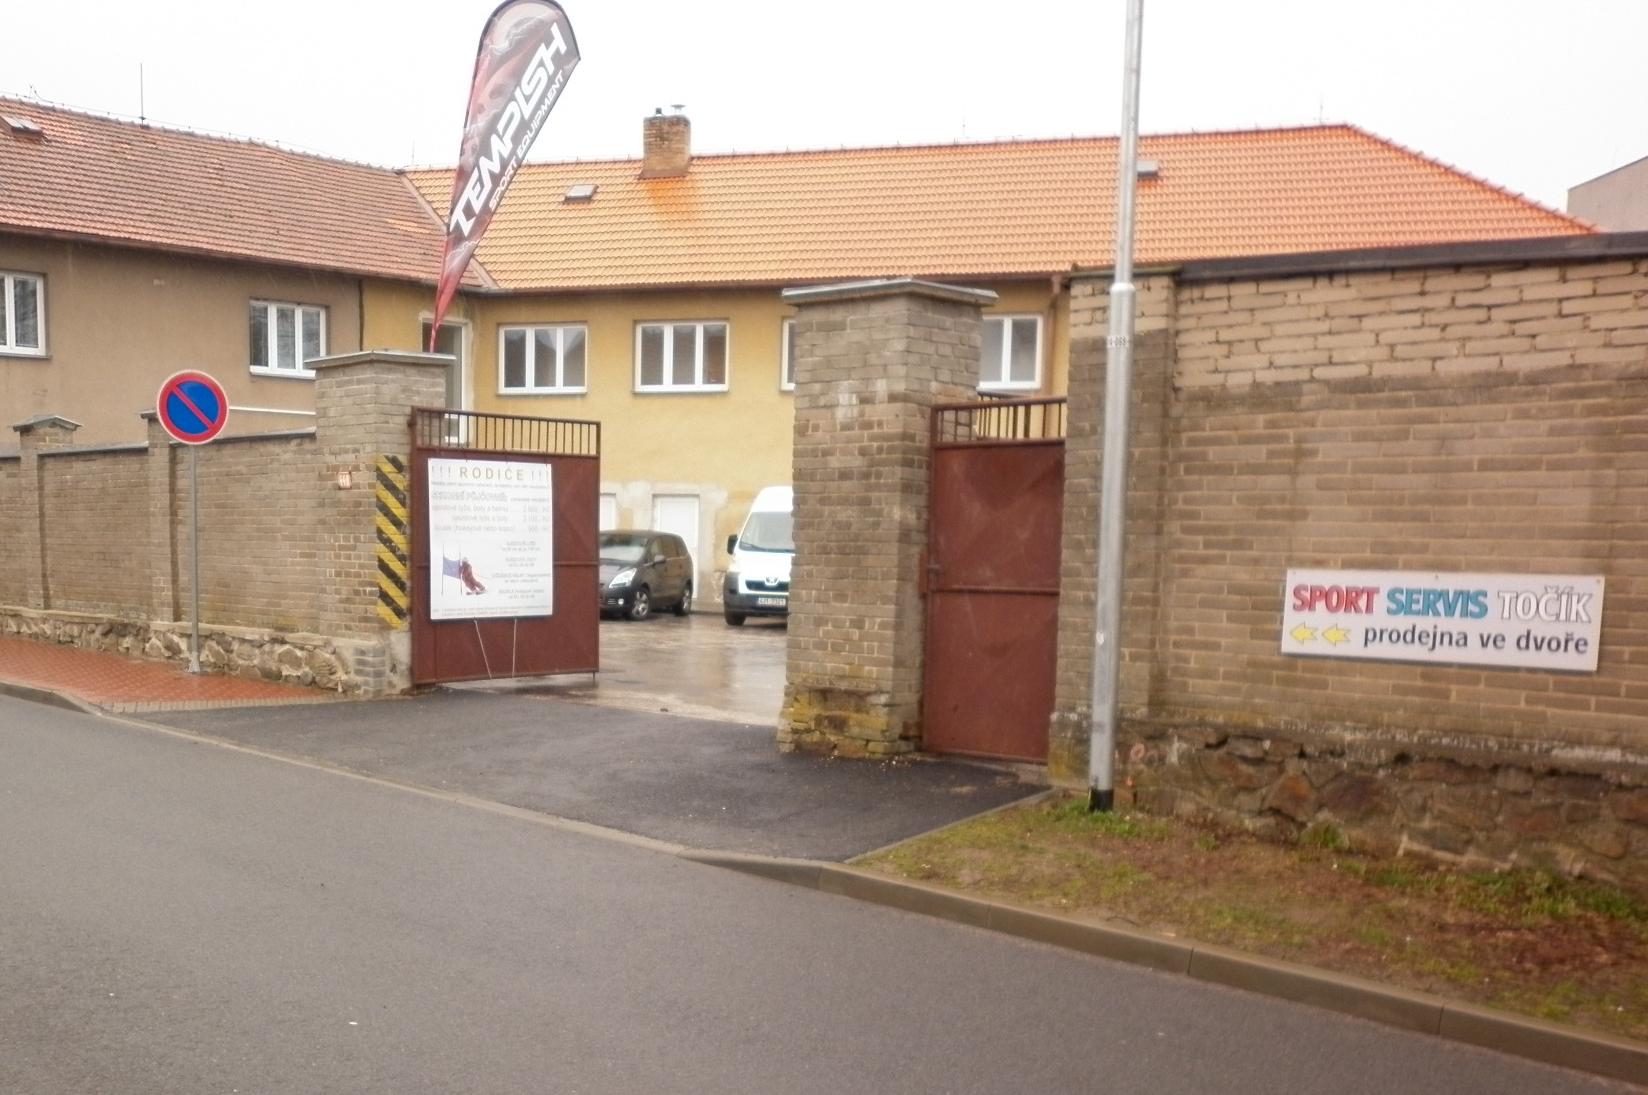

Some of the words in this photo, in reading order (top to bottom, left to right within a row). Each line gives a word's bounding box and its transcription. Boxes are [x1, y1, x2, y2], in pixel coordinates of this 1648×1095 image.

[450, 22, 567, 236] TEMPISH
[489, 156, 518, 211] SPORT
[516, 70, 565, 159] EQUIPMENT
[1292, 583, 1380, 614] SPORT
[1386, 586, 1489, 620] SERVIS
[1497, 584, 1595, 624] TOČÍK
[1363, 624, 1468, 651] prodejna
[1478, 632, 1506, 650] ve
[1516, 629, 1589, 655] dvoře
